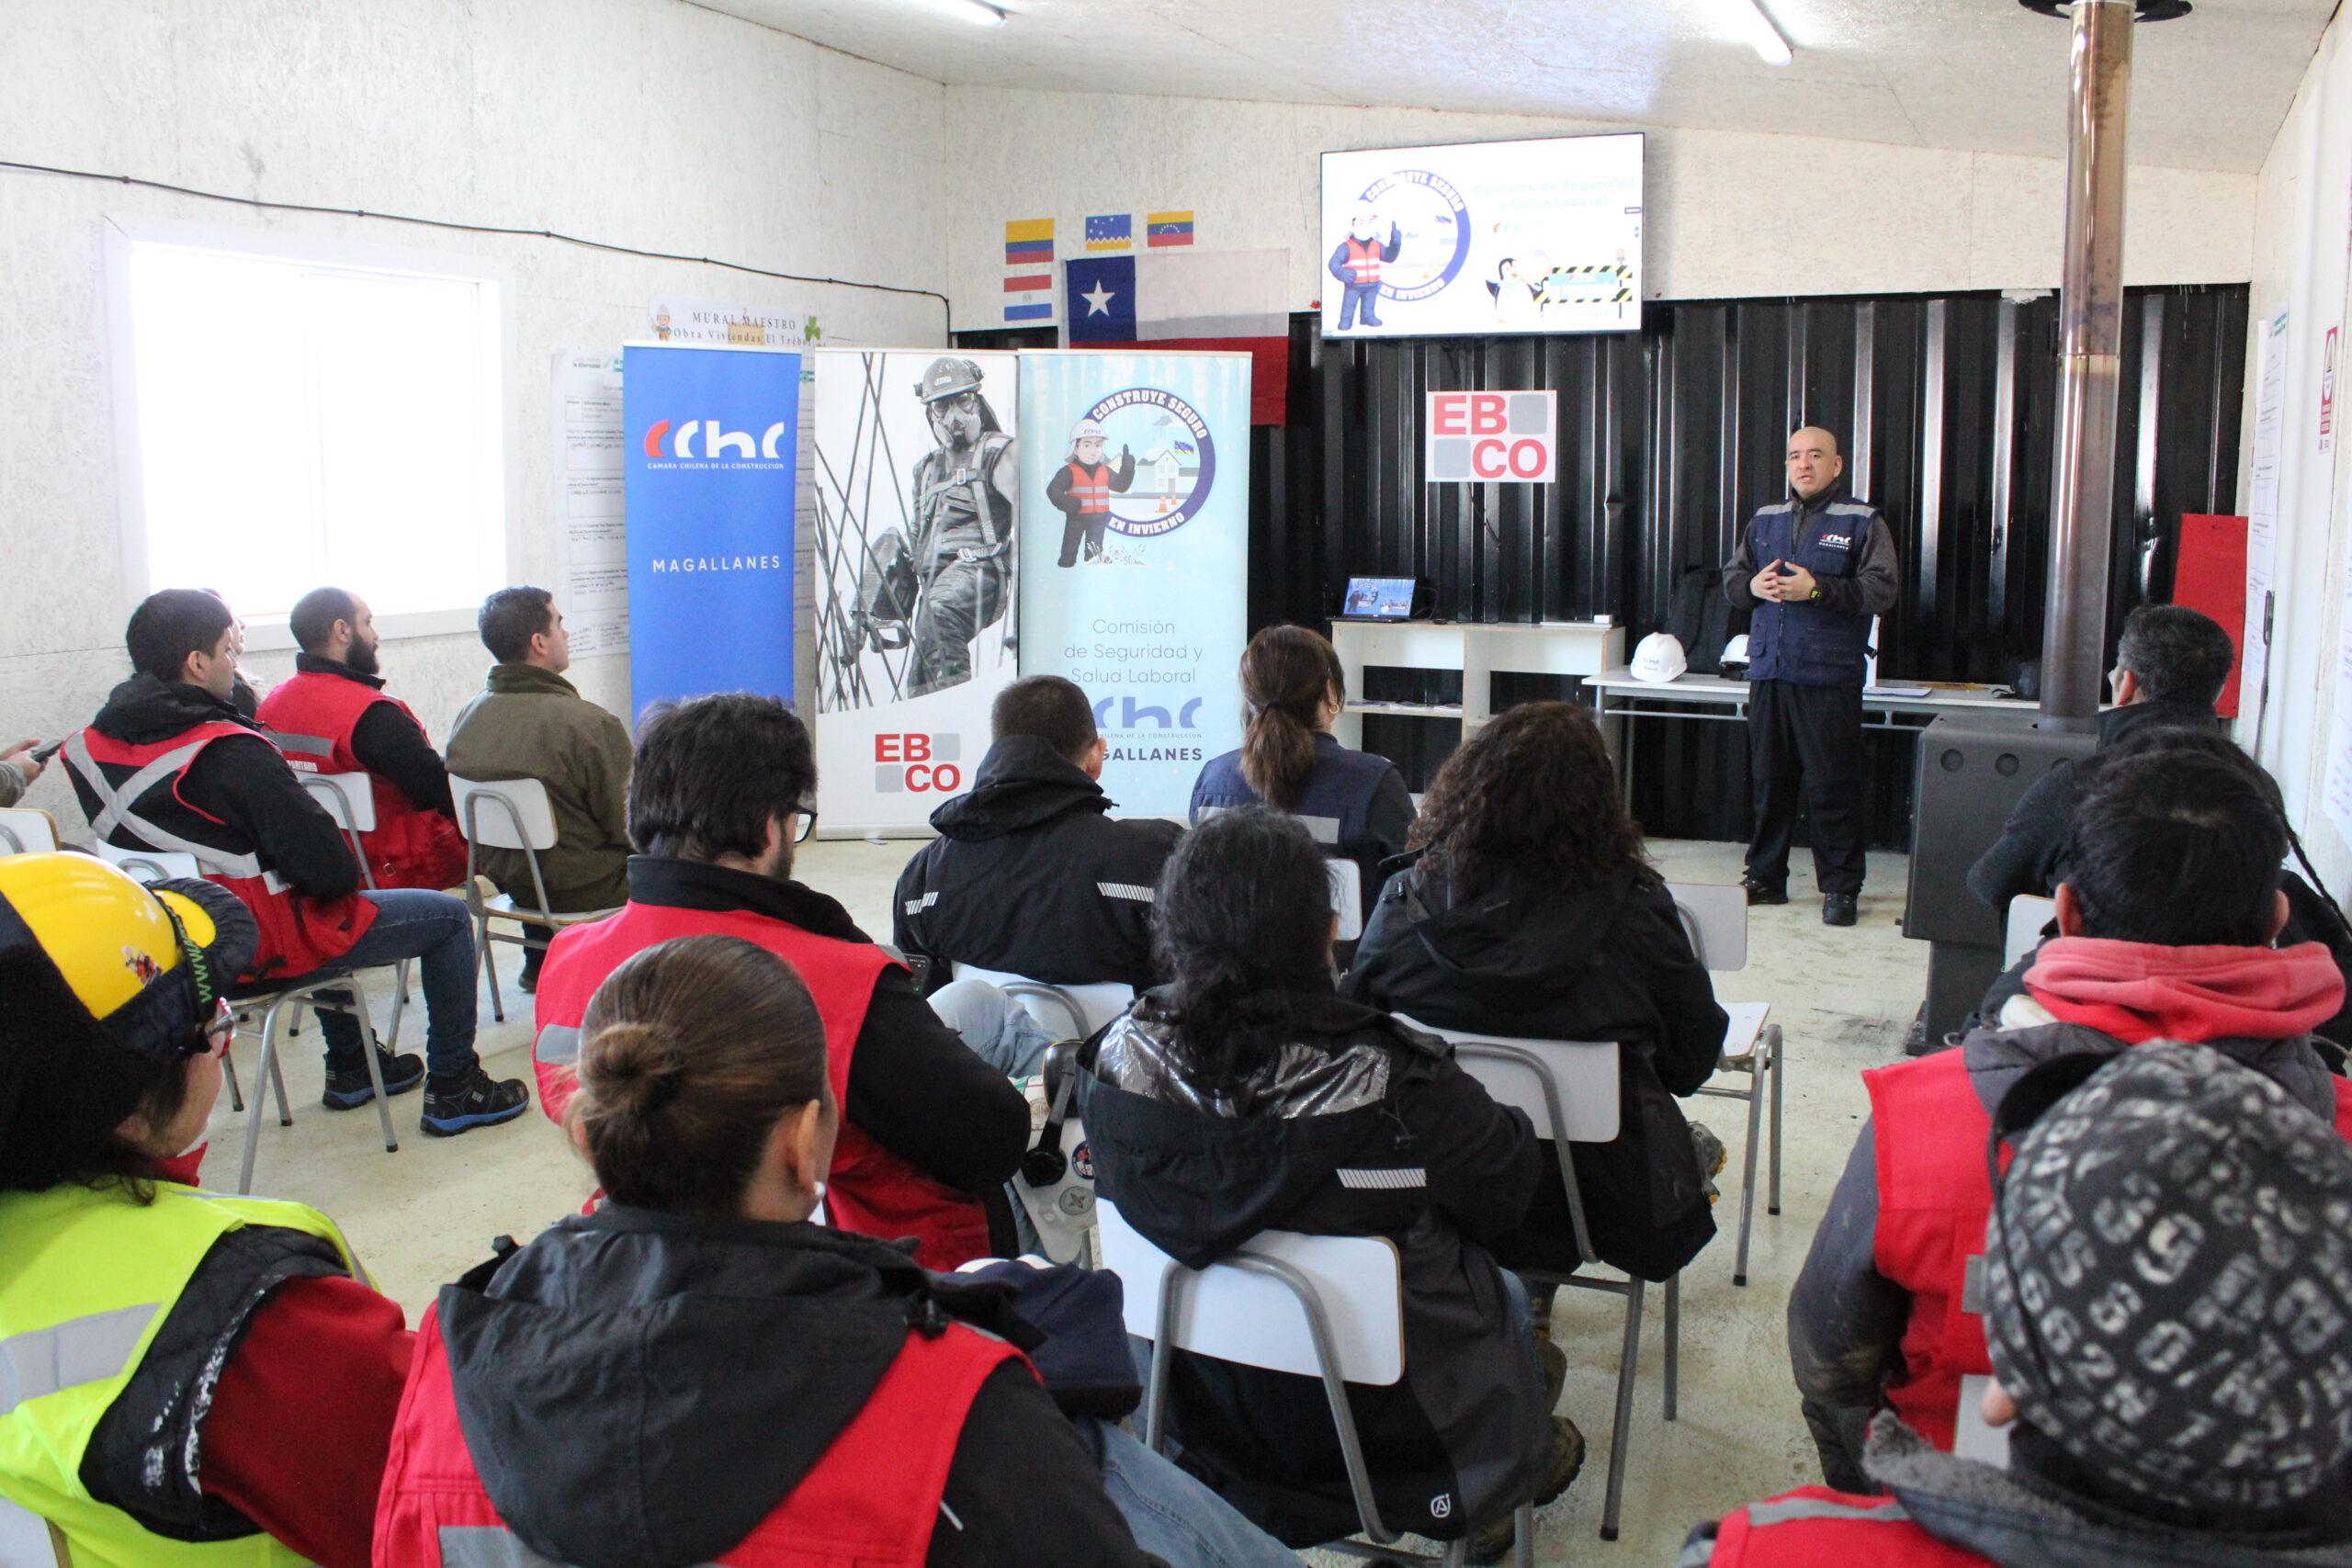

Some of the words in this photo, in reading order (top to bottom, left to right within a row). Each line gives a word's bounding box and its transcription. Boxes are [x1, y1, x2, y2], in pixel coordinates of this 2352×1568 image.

[693, 311, 737, 325] MURAL
[742, 315, 796, 330] MAESTRO
[673, 327, 702, 338] Obra
[766, 333, 775, 344] El
[1091, 389, 1167, 420] CONSTRUYE
[1168, 398, 1207, 439] SEGURO
[1108, 517, 1125, 531] EN
[1128, 513, 1185, 535] INVIERNO
[652, 555, 781, 573] MAGALLANES
[1092, 619, 1175, 635] Comisión
[1064, 645, 1087, 659] de
[1094, 644, 1187, 661] Seguridad
[1193, 648, 1204, 661] y
[1071, 668, 1121, 683] Salud
[1129, 668, 1195, 683] Laboral
